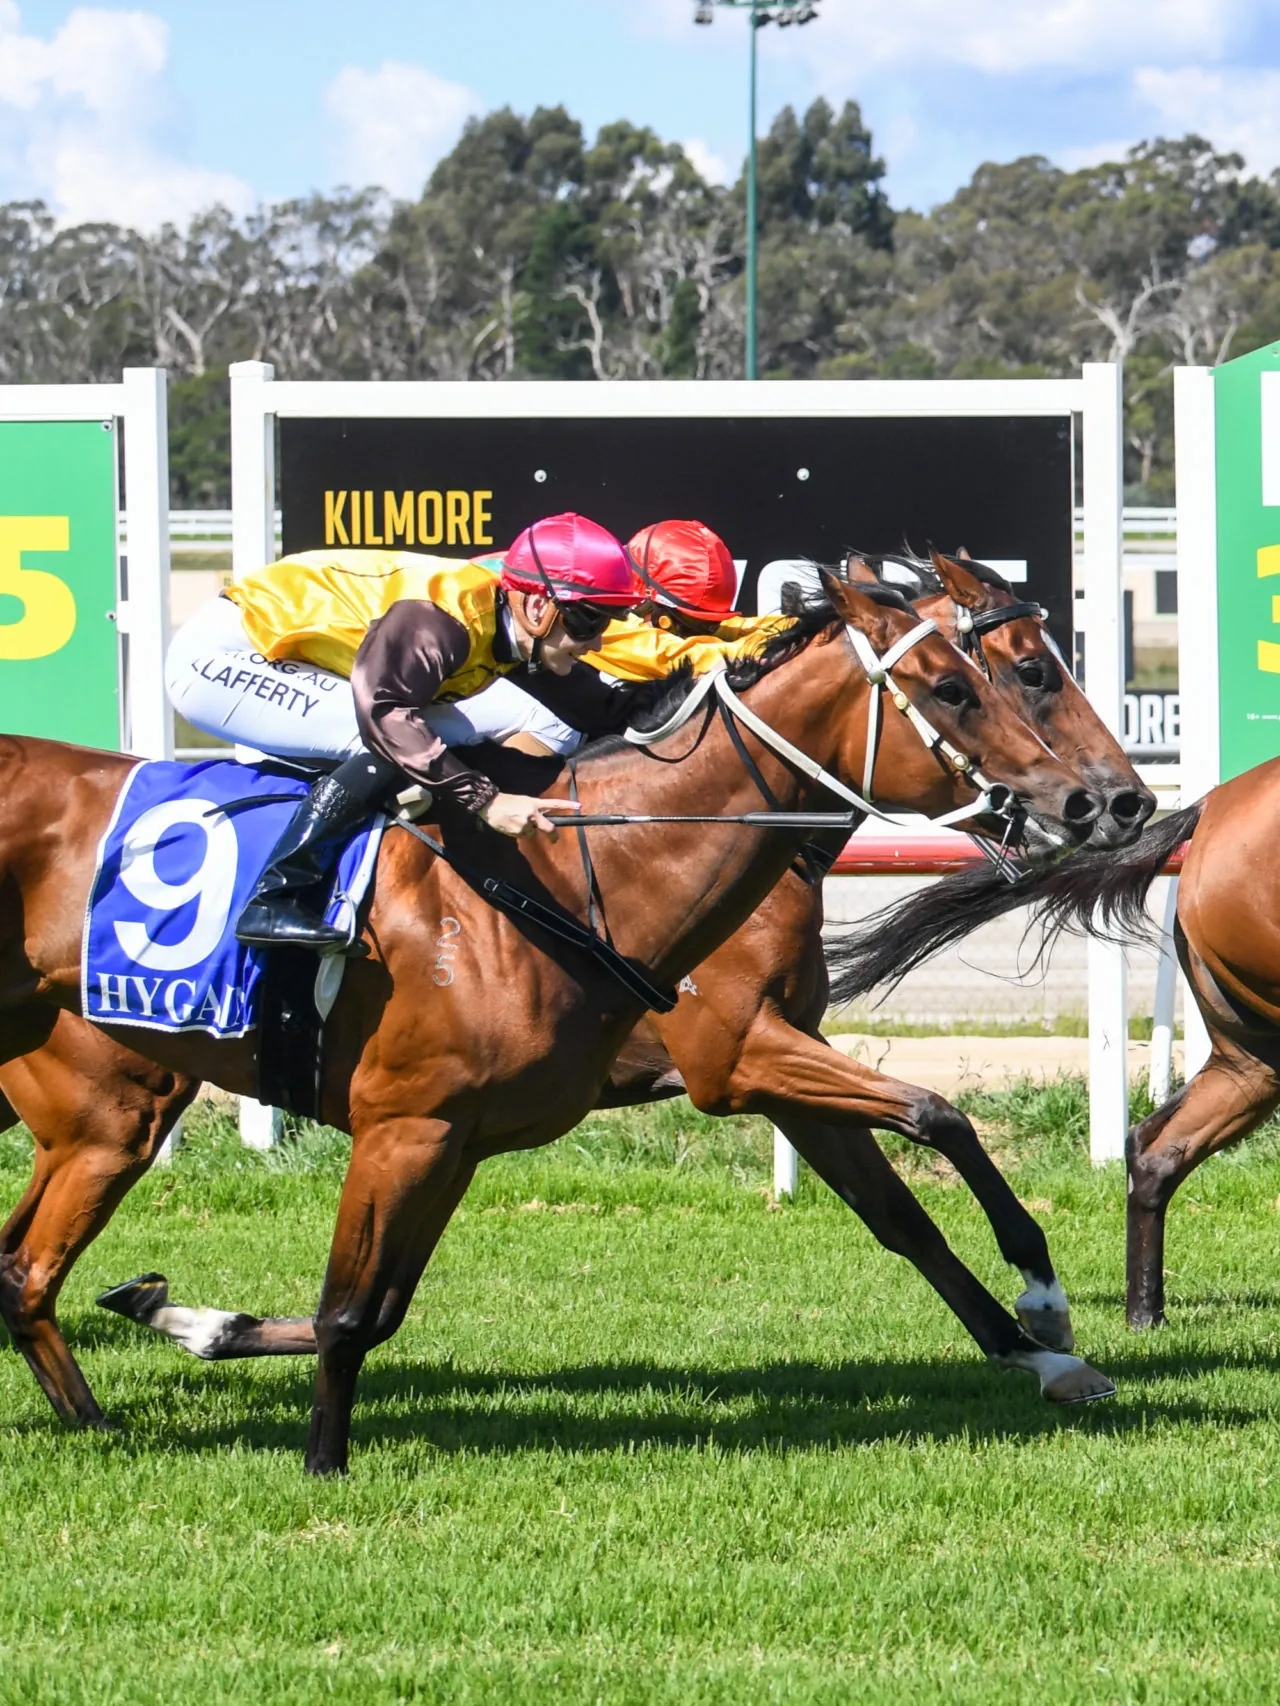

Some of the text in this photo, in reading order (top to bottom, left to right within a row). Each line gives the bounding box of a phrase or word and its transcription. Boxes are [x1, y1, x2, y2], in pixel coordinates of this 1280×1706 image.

[325, 490, 493, 545] KILMORE
[200, 657, 319, 718] LAFFERTY
[113, 798, 239, 971] 9
